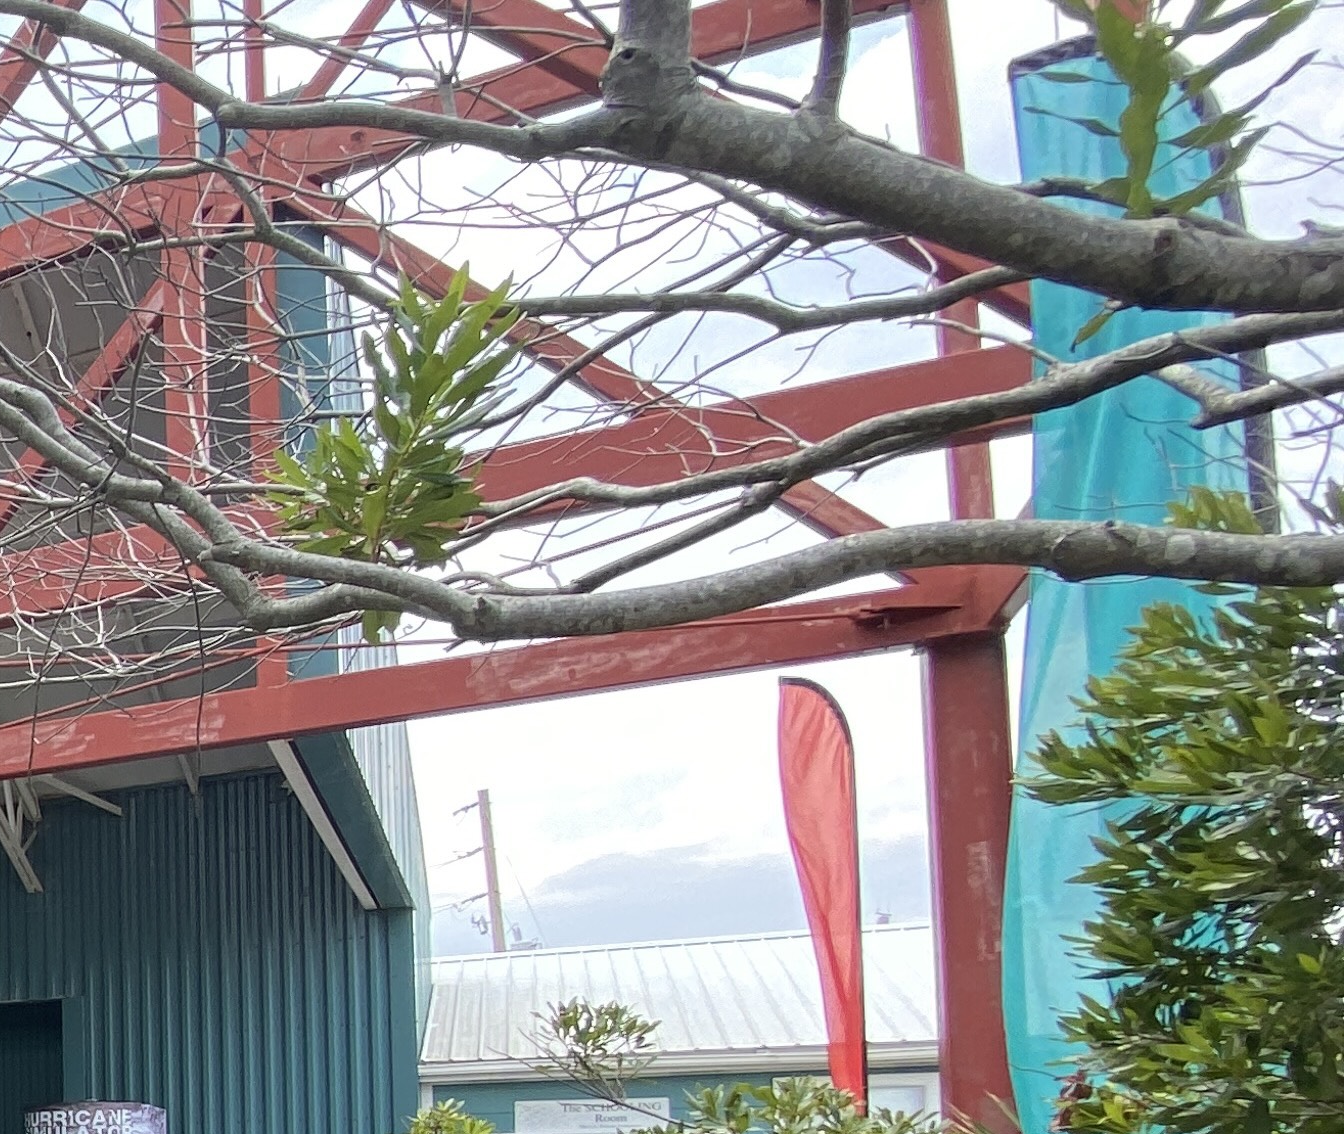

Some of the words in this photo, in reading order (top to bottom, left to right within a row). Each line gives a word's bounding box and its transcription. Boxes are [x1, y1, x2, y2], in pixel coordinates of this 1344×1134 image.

[563, 1103, 581, 1113] The
[585, 1102, 662, 1112] SCHOOING
[24, 1109, 133, 1128] HURRICANE
[595, 1114, 628, 1123] Room
